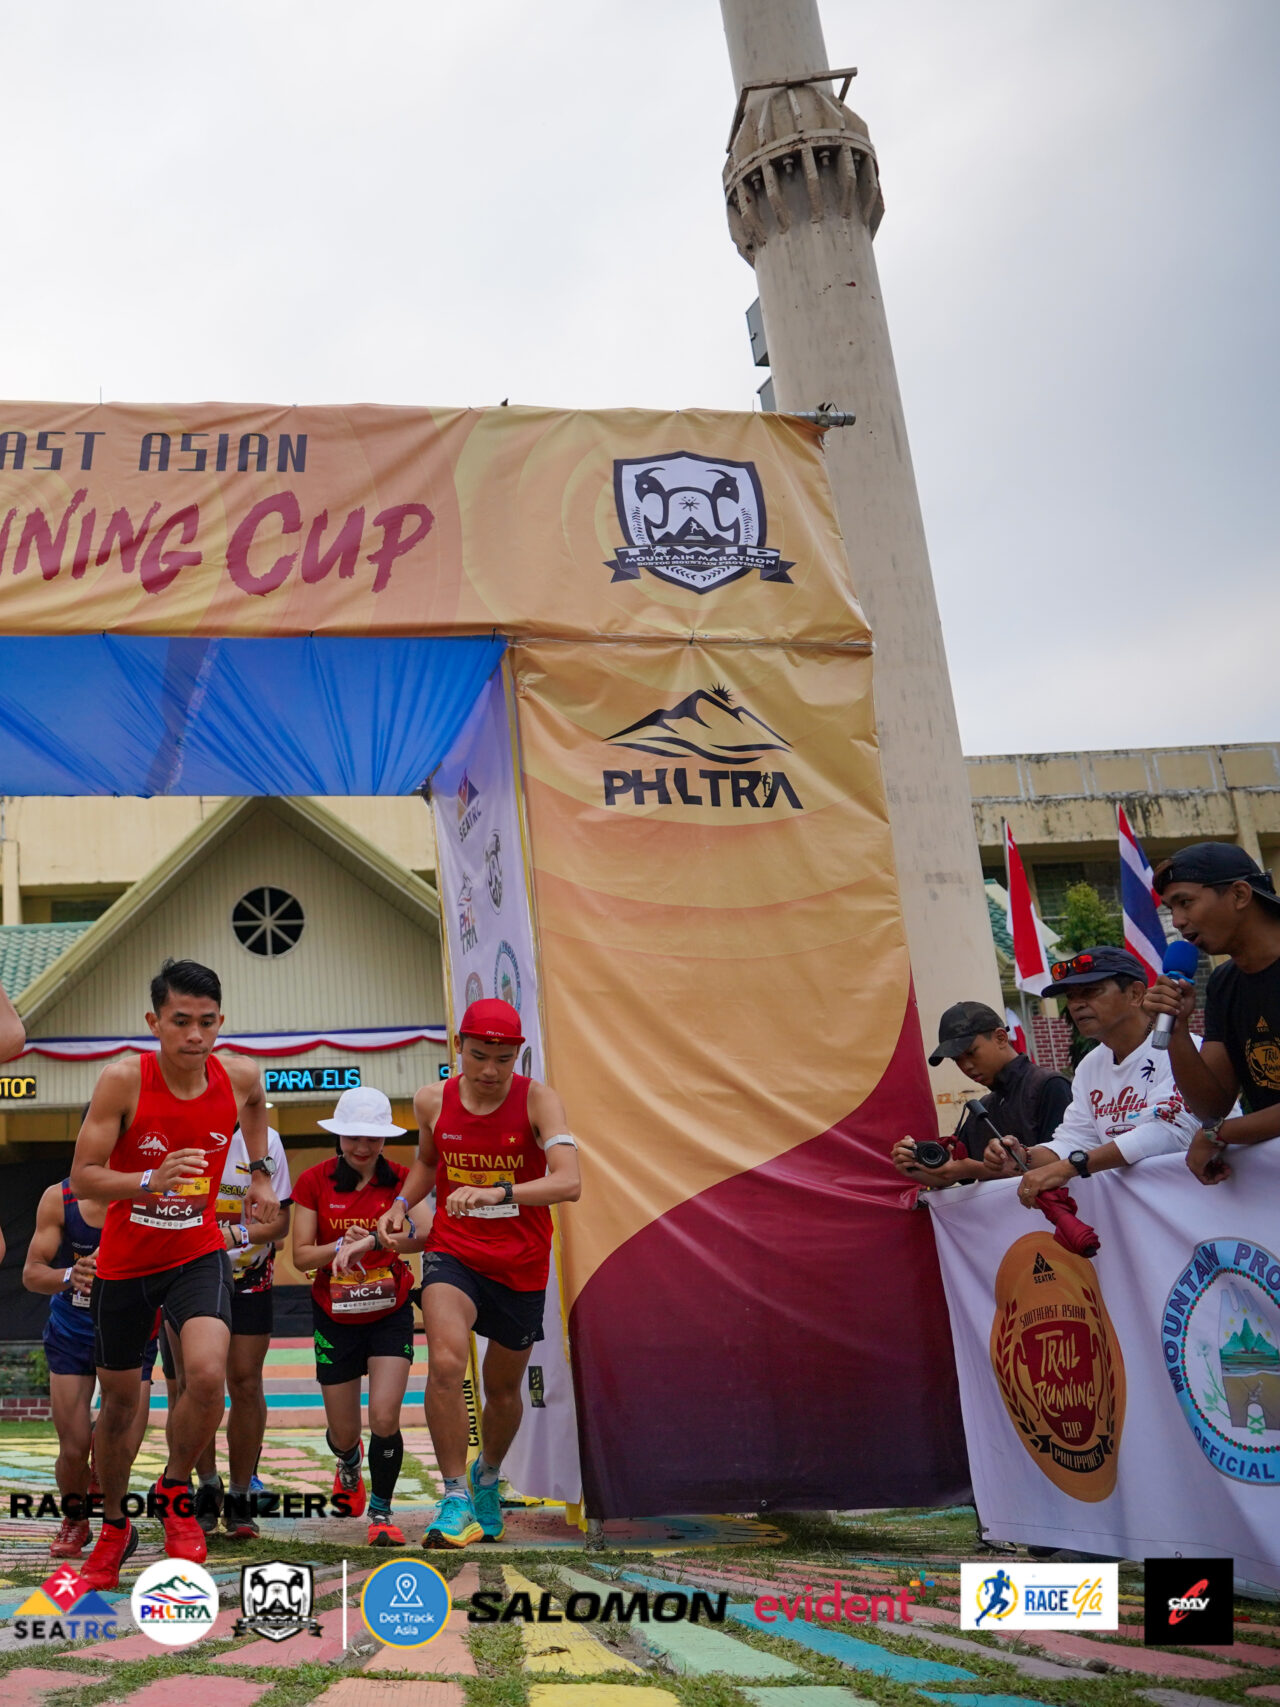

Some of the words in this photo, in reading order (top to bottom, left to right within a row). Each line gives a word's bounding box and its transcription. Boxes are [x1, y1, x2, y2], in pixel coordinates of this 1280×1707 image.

[138, 432, 308, 472] ASIAN
[226, 489, 435, 598] CUP
[625, 553, 695, 563] MOUNTAIN
[698, 555, 776, 565] MARATHON
[265, 1069, 361, 1090] PARACELIS
[443, 1151, 524, 1169] VIETNAM
[156, 1204, 192, 1216] MC-6
[329, 1218, 378, 1230] VIETNA
[1033, 1273, 1056, 1284] SEATRC
[350, 1286, 382, 1298] MC-4
[1061, 1304, 1086, 1320] ASIAN
[1035, 1330, 1080, 1377] TRAIL
[1035, 1375, 1095, 1417] RUNNING
[1061, 1421, 1083, 1439] CUP
[1054, 1446, 1102, 1471] PHILIPPINES
[1192, 1425, 1274, 1479] OFFICIAL
